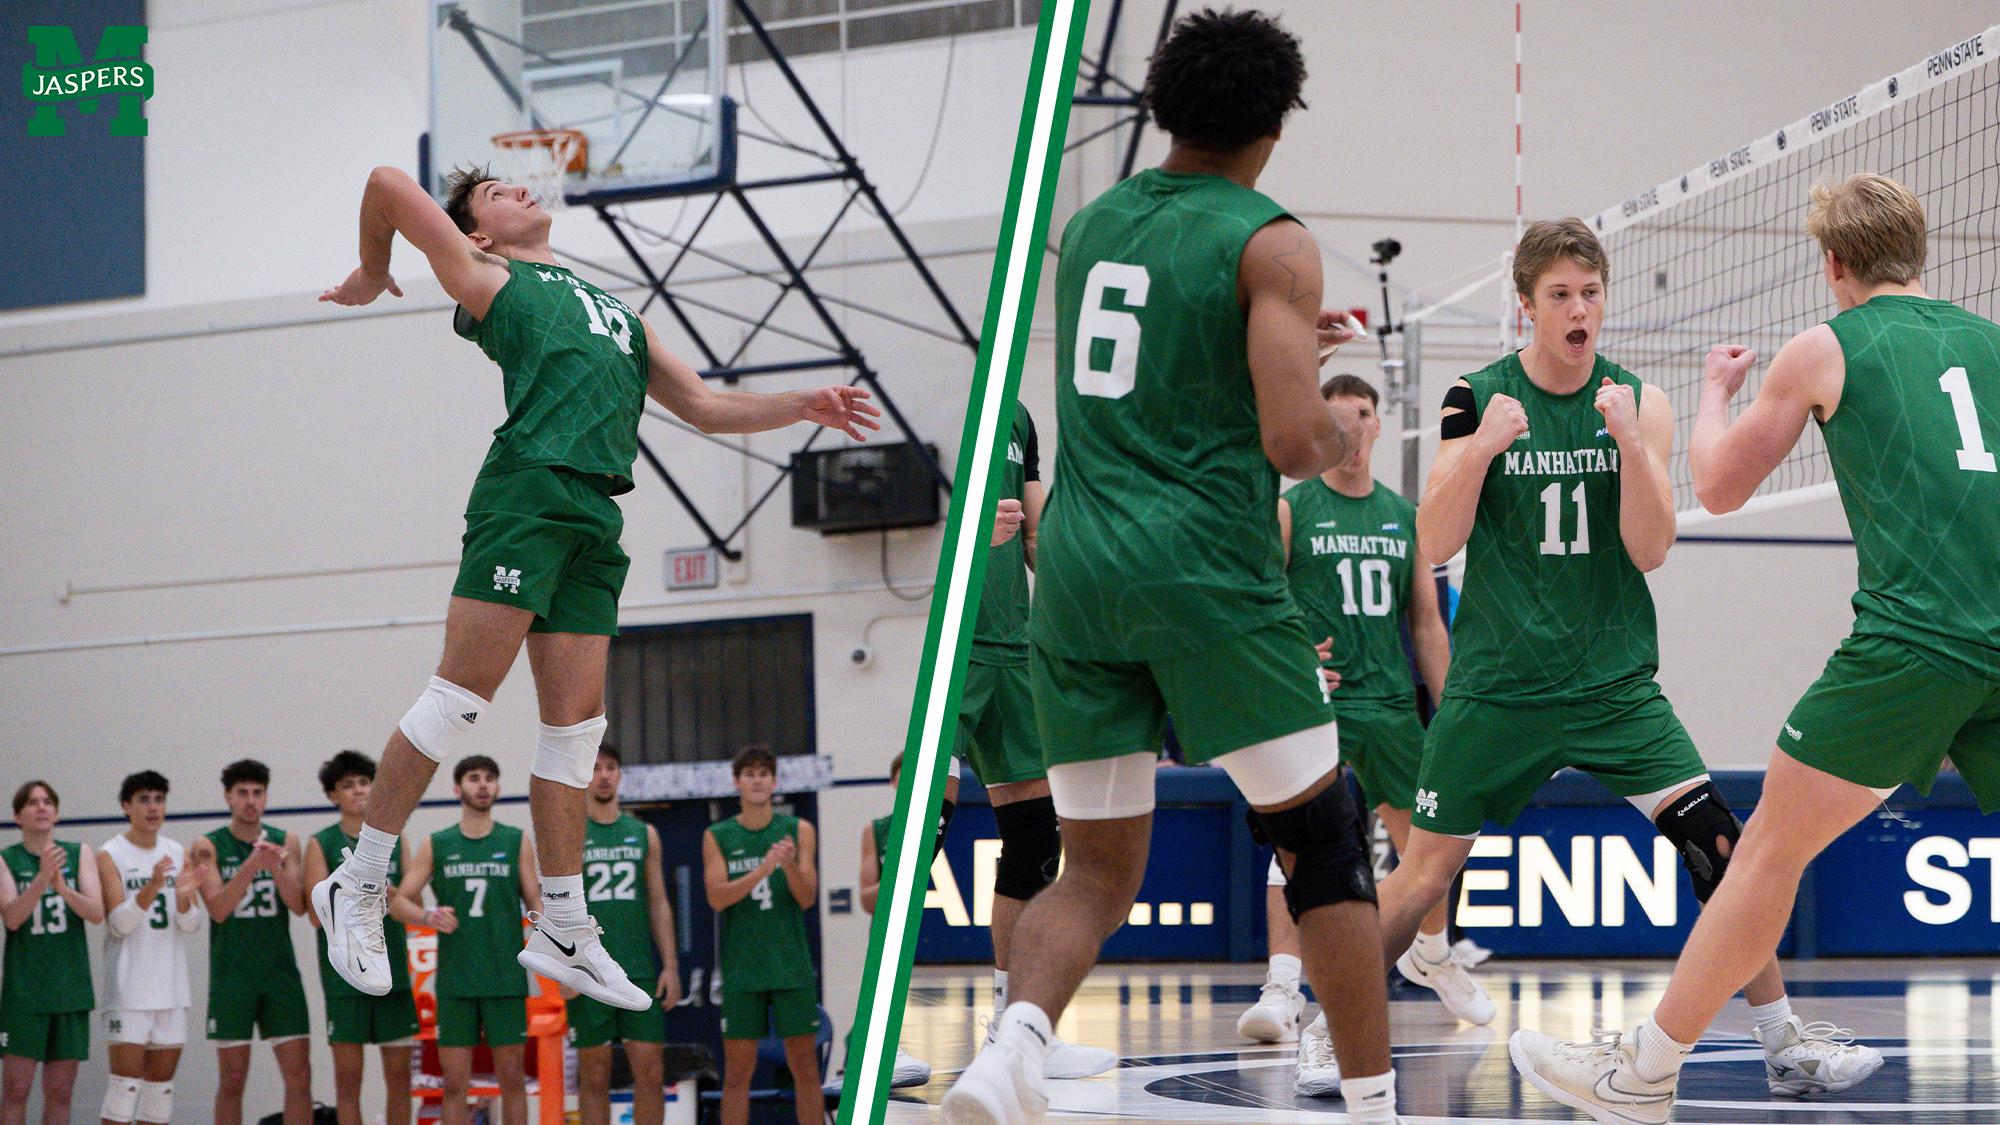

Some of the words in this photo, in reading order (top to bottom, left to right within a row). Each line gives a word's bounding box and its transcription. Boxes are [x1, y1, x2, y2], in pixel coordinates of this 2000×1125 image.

[1927, 50, 1953, 78] PENN
[1953, 35, 1985, 67] STATE
[1810, 112, 1832, 134] PENN
[1833, 95, 1859, 123] STATE
[1073, 260, 1150, 399] 6
[1938, 366, 1998, 472] 1
[1504, 447, 1618, 475] MANHATTAN
[1540, 481, 1590, 556] 11
[1310, 534, 1407, 559] MANHATTAN
[1336, 558, 1392, 617] 10
[582, 846, 643, 862] ANHATTAN
[233, 879, 278, 919] 23
[362, 883, 376, 891] NIKE
[465, 877, 488, 918] 7
[587, 861, 636, 902] 22
[751, 876, 773, 911] 4
[30, 895, 68, 935] 13
[150, 893, 169, 930] 3
